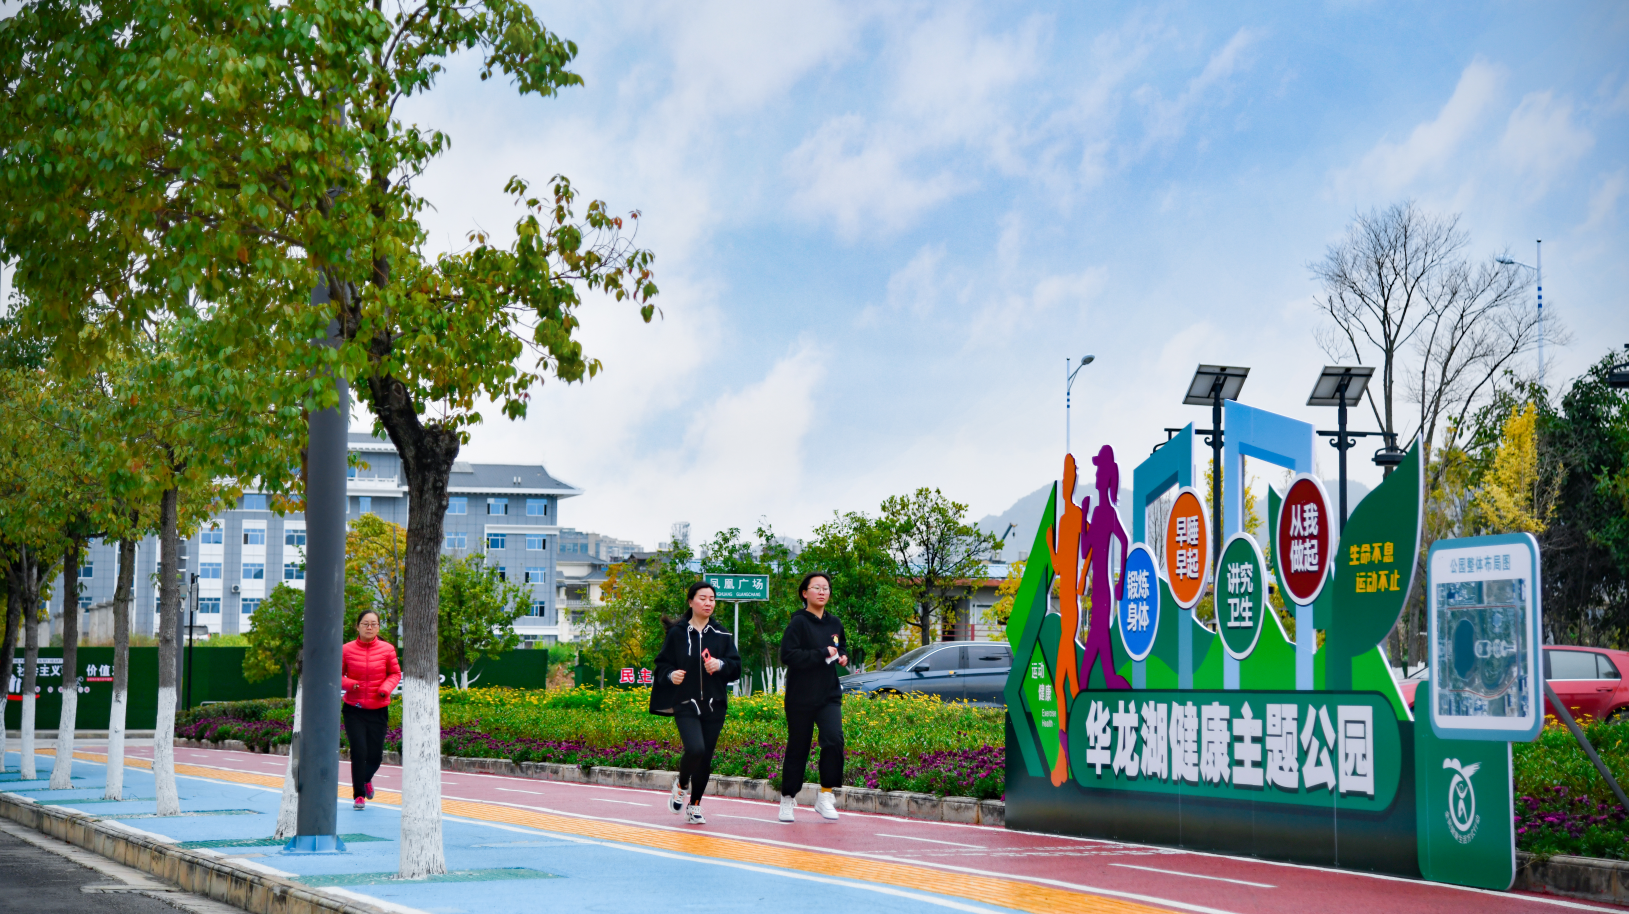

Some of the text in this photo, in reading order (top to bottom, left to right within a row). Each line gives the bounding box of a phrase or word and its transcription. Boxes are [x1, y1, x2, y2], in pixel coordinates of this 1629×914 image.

[1176, 515, 1199, 547] 早睡
[1290, 503, 1319, 537] 从我
[1176, 548, 1199, 580] 早起
[1290, 539, 1319, 573] 做起
[1349, 542, 1394, 566] 生命不息
[1450, 554, 1511, 573] 公园整体布局图
[710, 578, 764, 590] 凤凰广场
[1127, 569, 1150, 600] 锻炼
[1227, 562, 1254, 594] 讲究
[1356, 569, 1401, 593] 运动不止
[1127, 601, 1150, 632] 身体
[1227, 596, 1253, 628] 卫生
[16, 664, 61, 676] 社主义
[86, 664, 114, 676] 价值
[620, 668, 653, 683] 民主
[1031, 661, 1045, 679] 运动
[1038, 684, 1052, 701] 健康
[1085, 700, 1375, 796] 华龙湖健康主题公园
